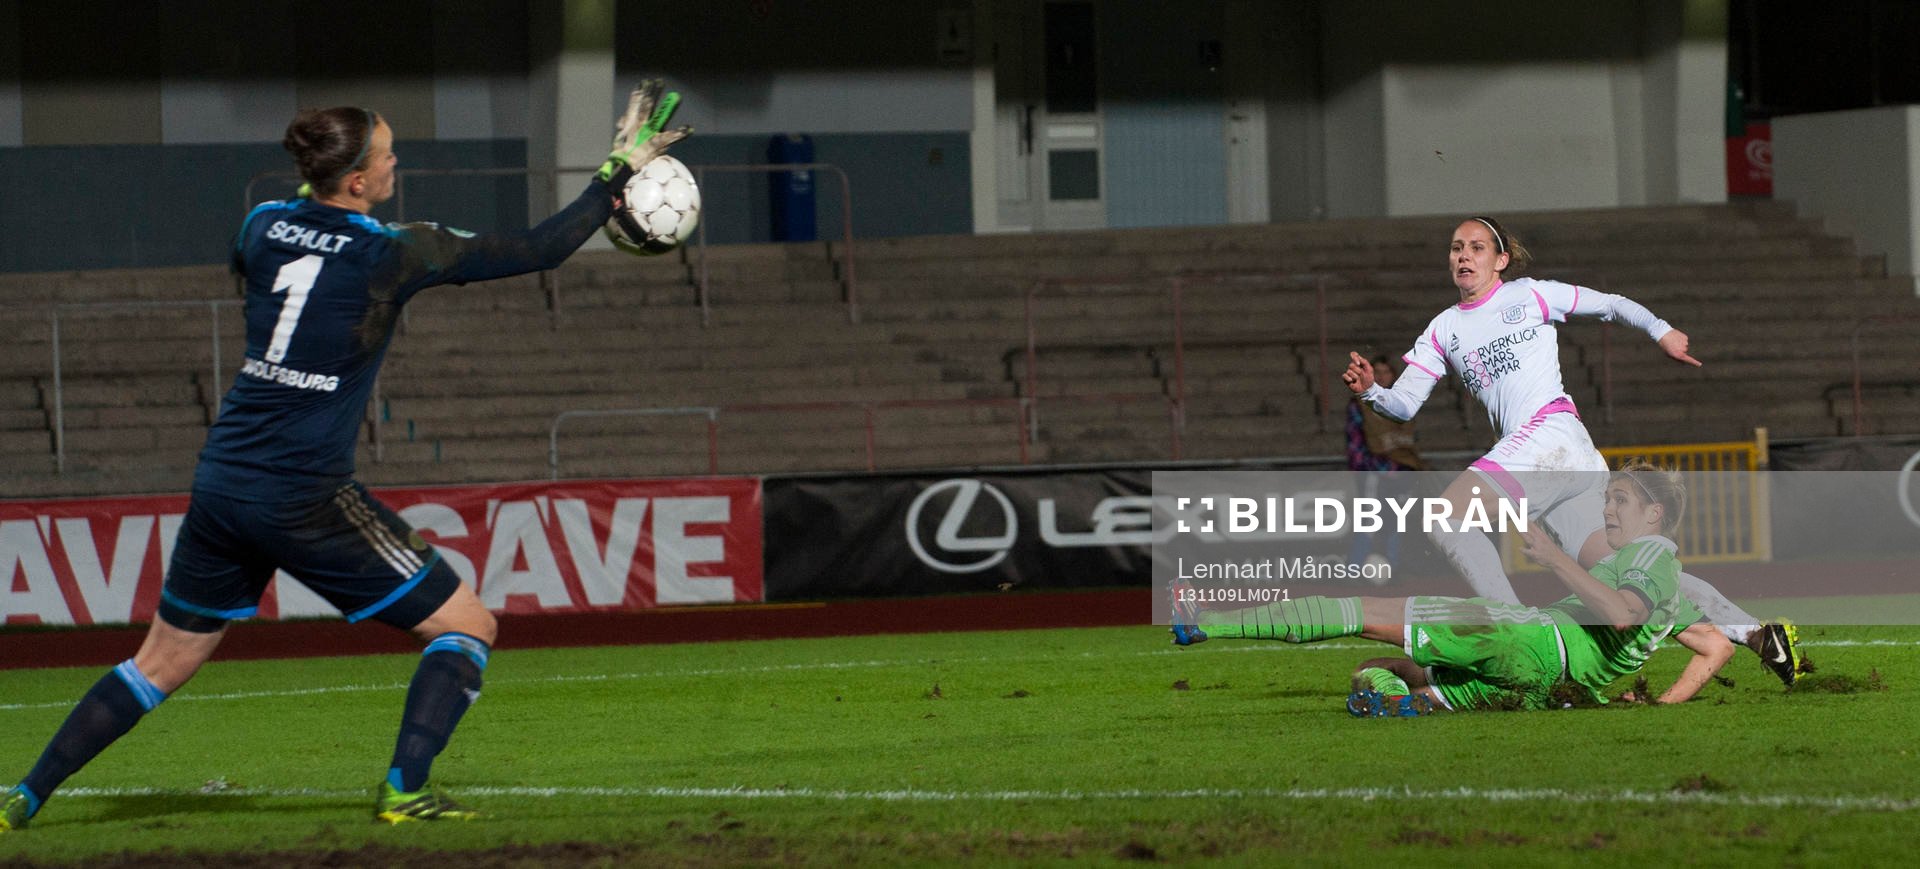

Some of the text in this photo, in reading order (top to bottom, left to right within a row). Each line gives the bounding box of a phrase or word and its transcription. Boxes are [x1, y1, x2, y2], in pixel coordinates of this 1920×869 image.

[267, 220, 353, 253] SCHULT
[265, 254, 325, 364] 1
[242, 357, 340, 391] WOLFSBURG
